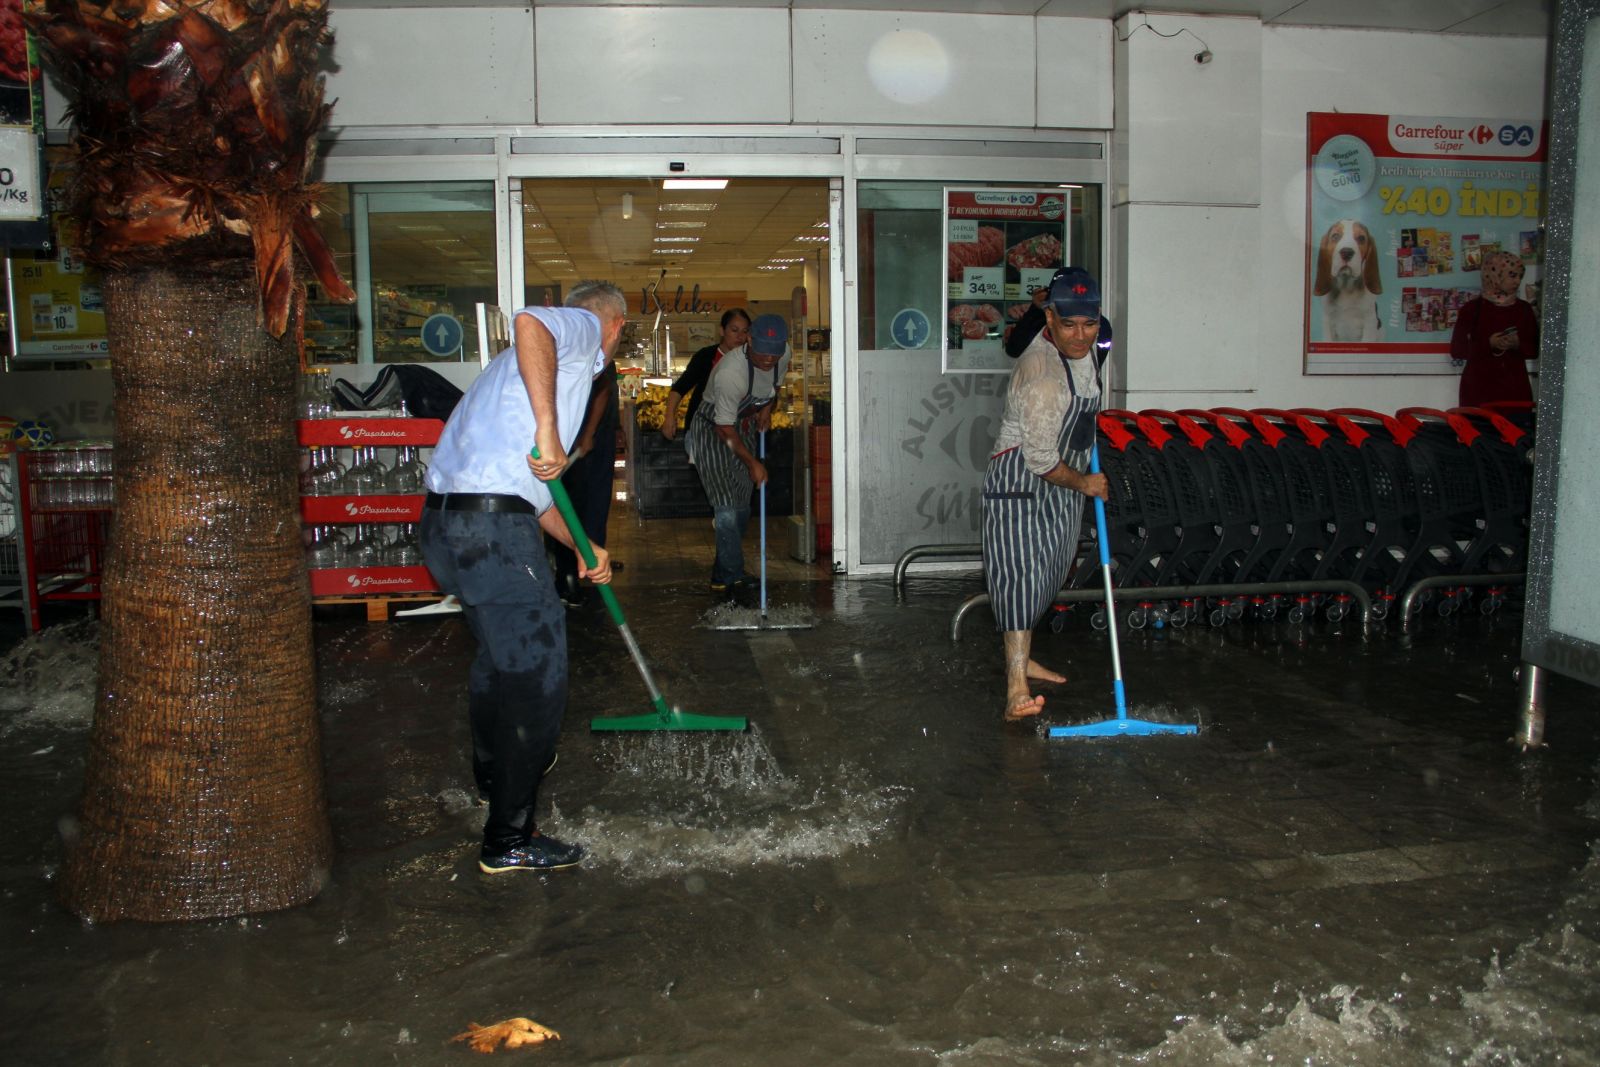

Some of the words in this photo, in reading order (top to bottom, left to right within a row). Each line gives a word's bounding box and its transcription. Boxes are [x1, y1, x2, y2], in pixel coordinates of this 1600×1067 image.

[1395, 124, 1464, 140] Carrefour
[1500, 128, 1532, 143] SA
[1434, 141, 1464, 153] süper
[1407, 166, 1437, 179] Köpek
[1380, 185, 1450, 216] %40
